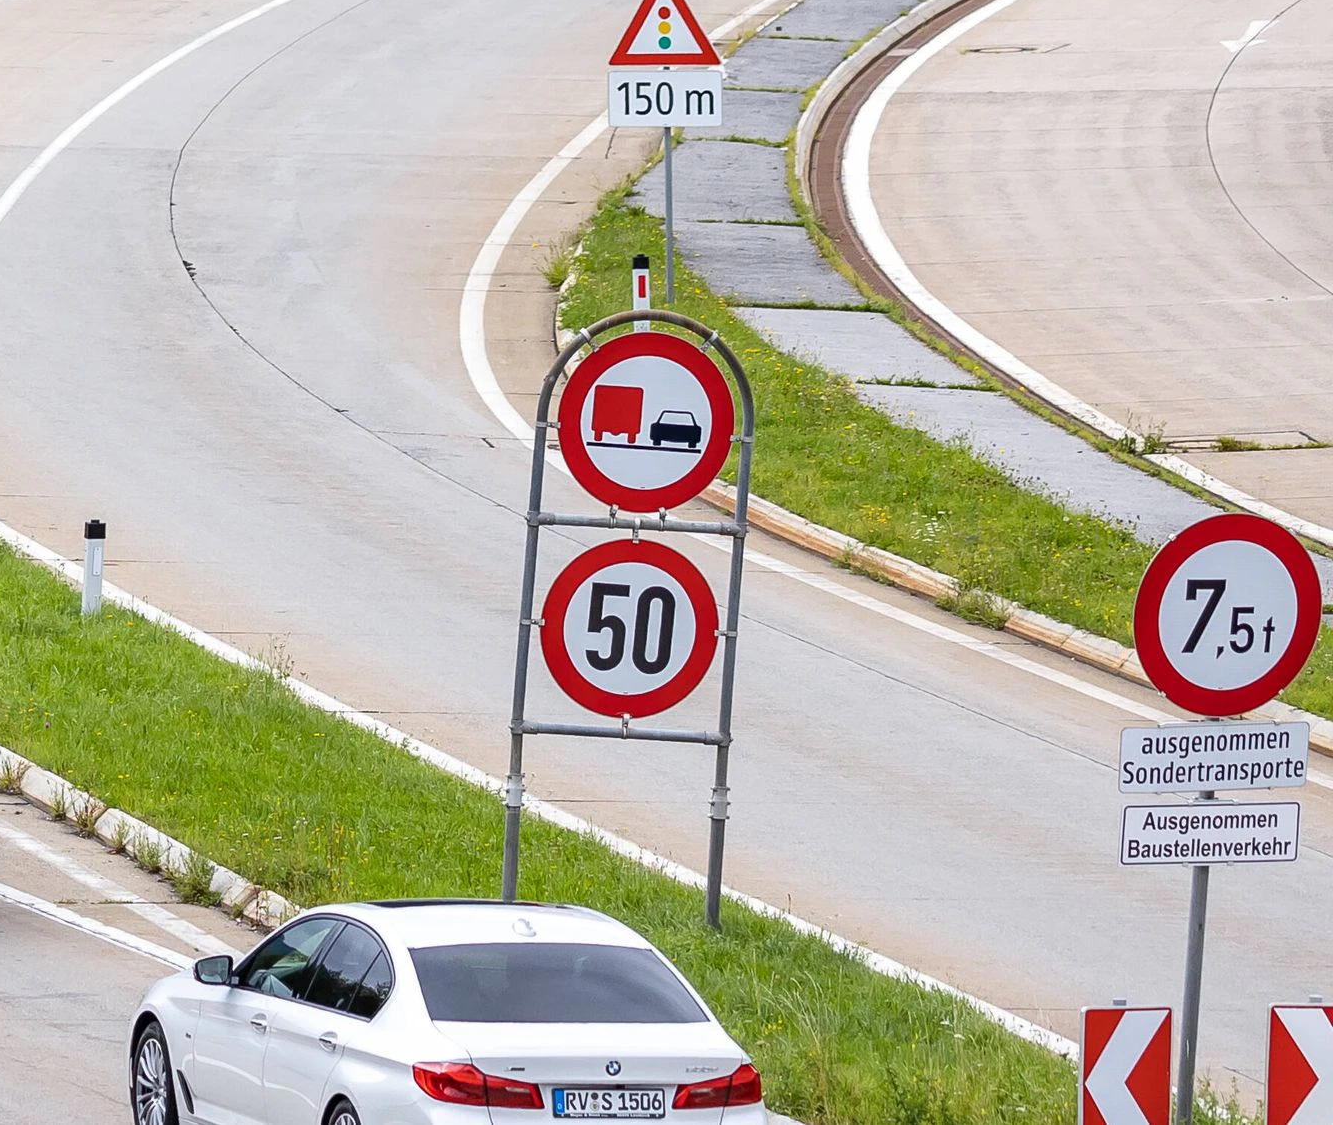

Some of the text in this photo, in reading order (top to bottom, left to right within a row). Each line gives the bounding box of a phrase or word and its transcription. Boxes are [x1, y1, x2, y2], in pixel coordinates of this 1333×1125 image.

[617, 82, 715, 116] 150 m
[585, 582, 676, 675] 50
[1181, 579, 1275, 659] 7,5 t
[1141, 731, 1290, 759] ausgenommen
[1123, 756, 1304, 785] Sondertransporte
[1142, 812, 1278, 835] Ausgenommen
[1127, 837, 1291, 860] Baustellenverkehr
[566, 1093, 588, 1110] RV
[602, 1093, 613, 1110] S
[618, 1092, 663, 1110] 1506
